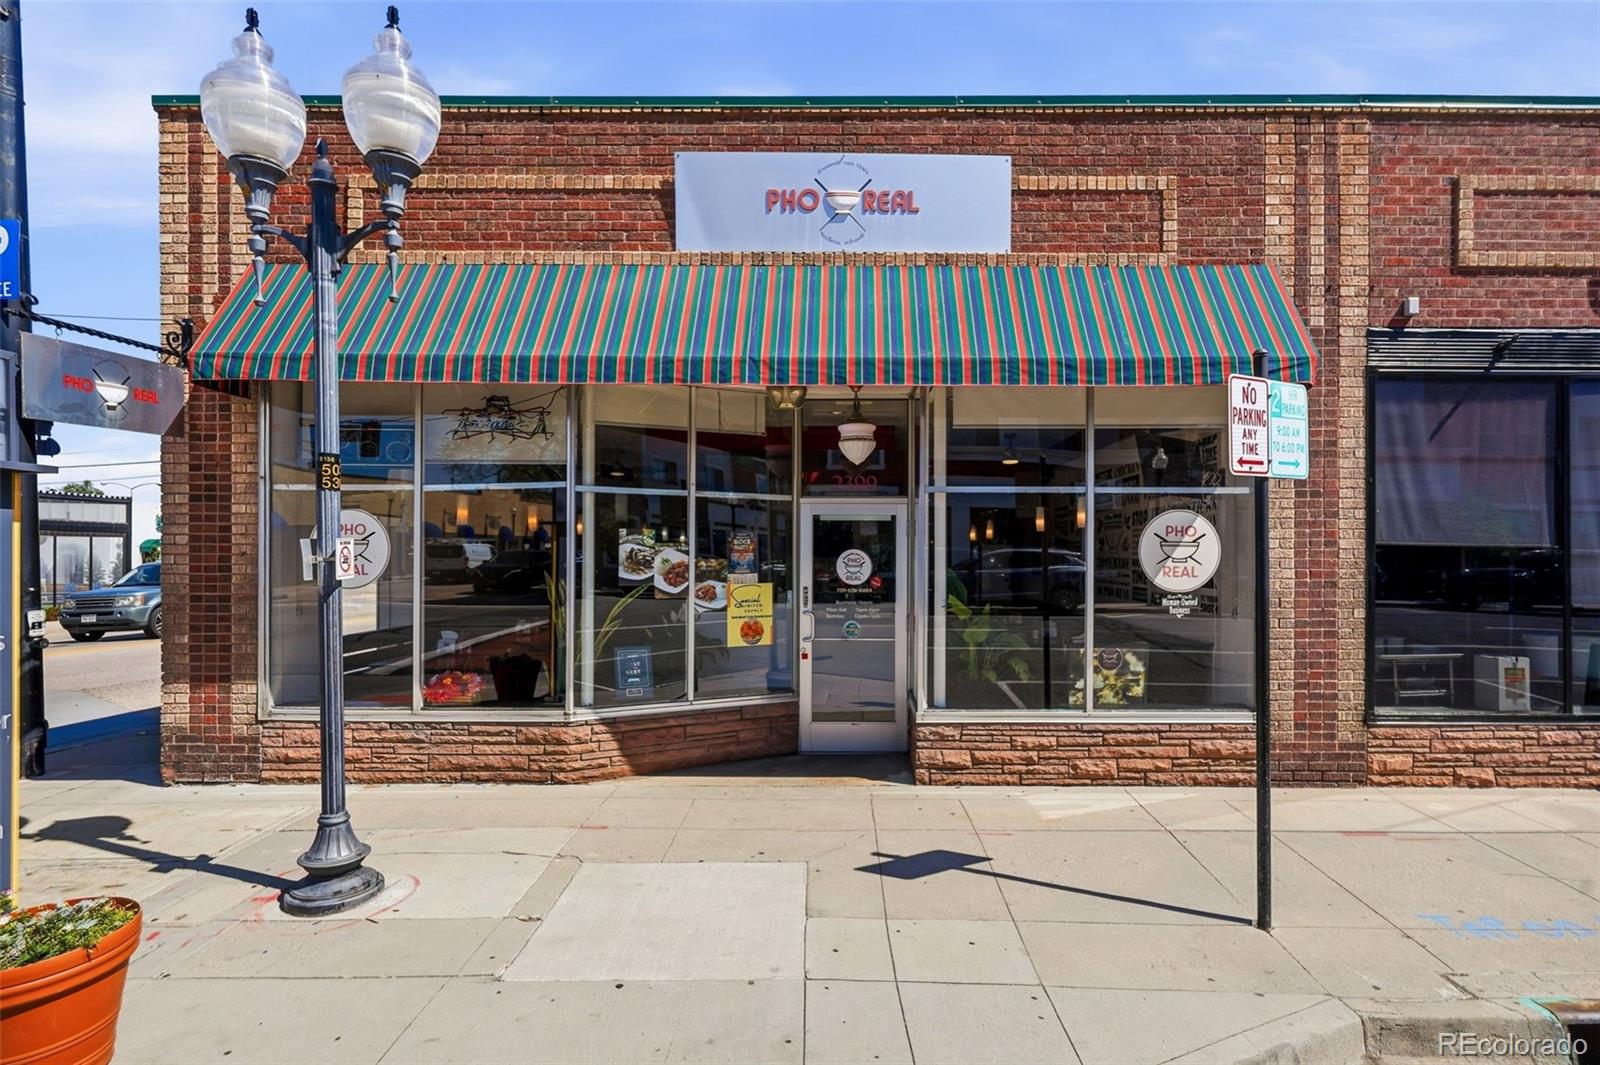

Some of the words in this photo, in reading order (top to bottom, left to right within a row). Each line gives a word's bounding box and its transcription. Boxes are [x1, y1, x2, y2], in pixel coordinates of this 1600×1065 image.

[765, 188, 820, 214] PHO
[861, 189, 920, 215] REAL
[63, 375, 95, 393] PHO
[133, 387, 160, 405] REAL
[1242, 386, 1257, 405] NO
[1271, 389, 1281, 413] 2
[1282, 403, 1305, 417] PARKING
[1232, 407, 1267, 428] PARKING
[1242, 428, 1258, 440] ANY
[1276, 425, 1291, 437] 9:00
[1291, 426, 1300, 437] AM
[1241, 442, 1259, 456] TIME
[1165, 525, 1197, 538] PHO
[1162, 566, 1199, 578] REAL
[1169, 606, 1190, 614] Business
